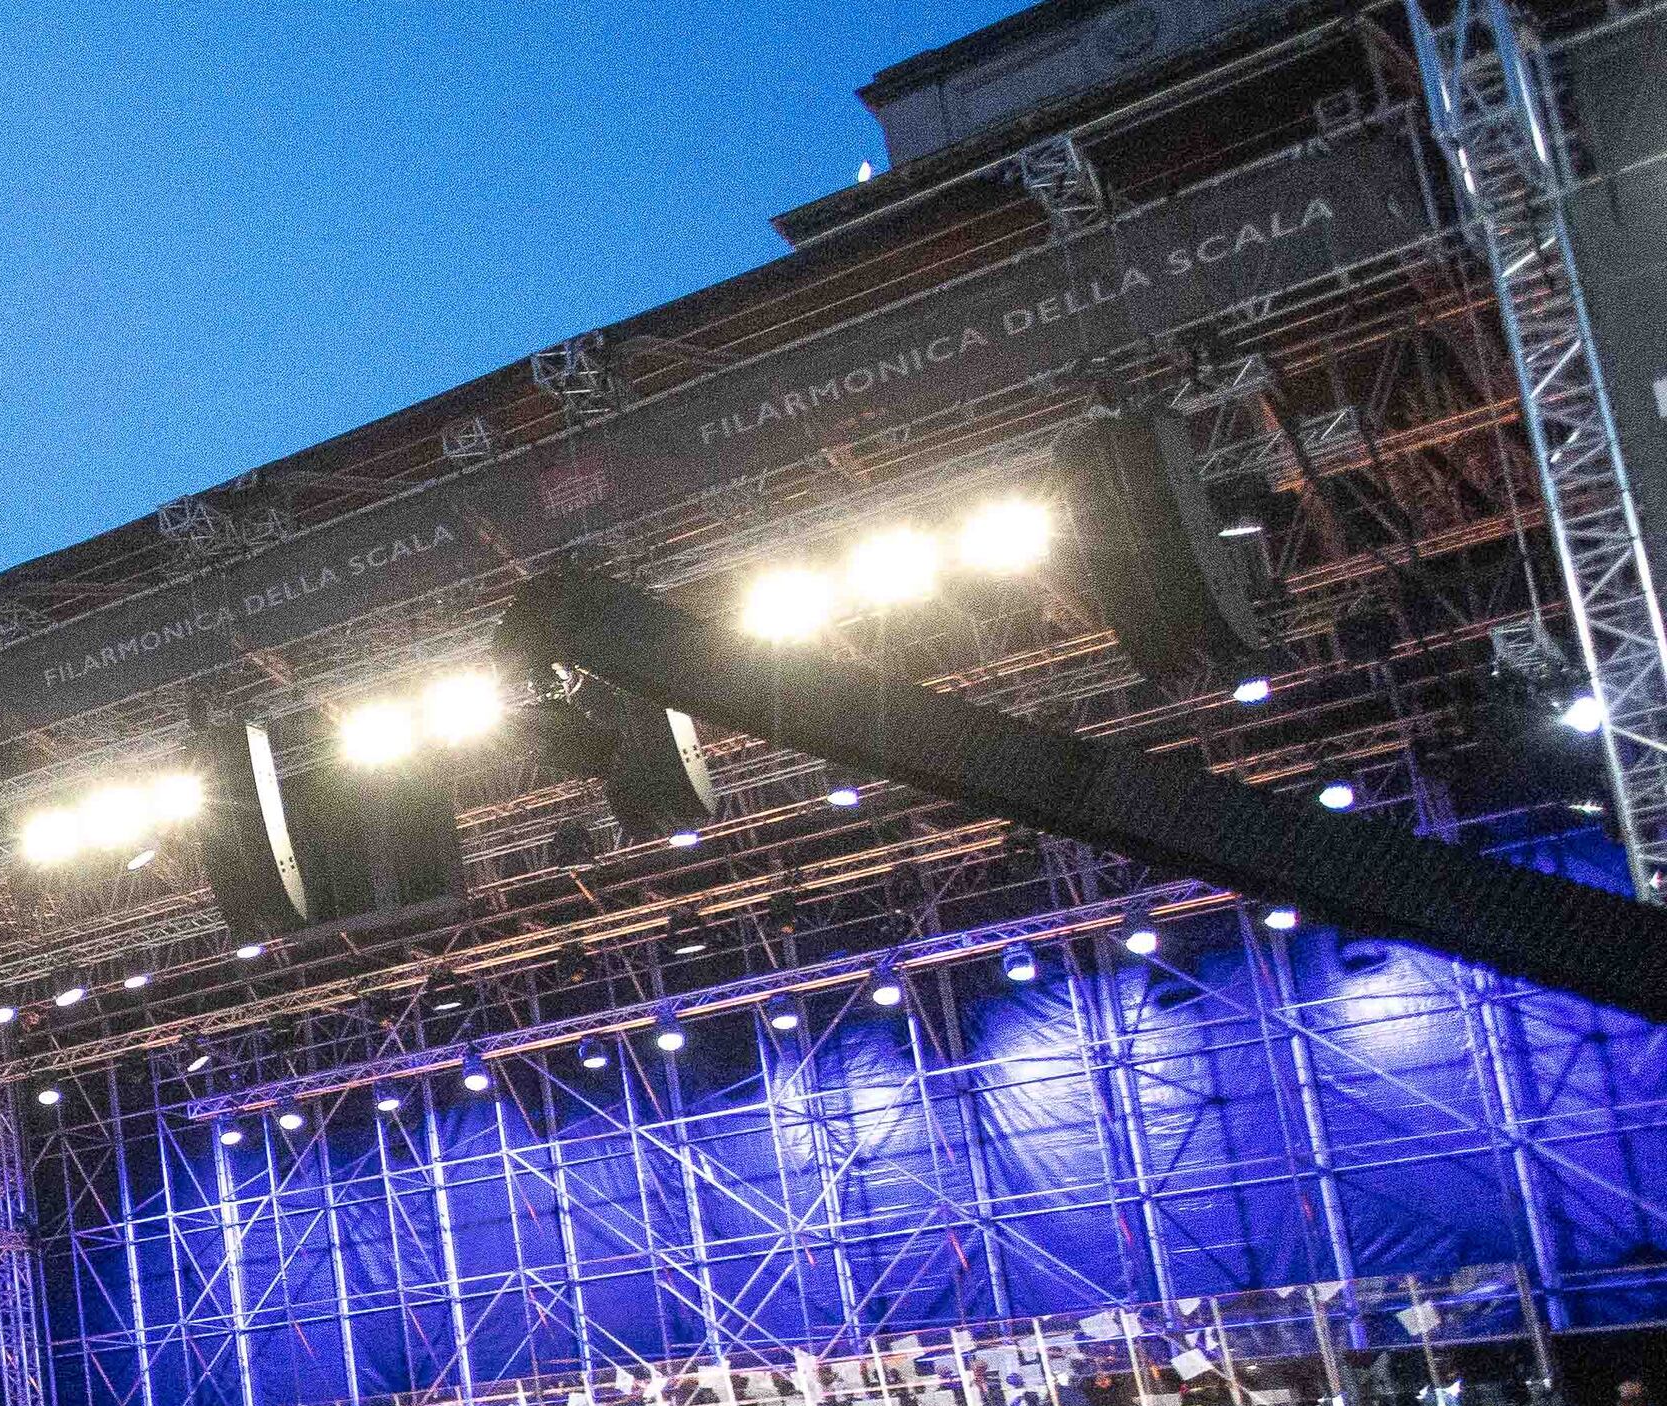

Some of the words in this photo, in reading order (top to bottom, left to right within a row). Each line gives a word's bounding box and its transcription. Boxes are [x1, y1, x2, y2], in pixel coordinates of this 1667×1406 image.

[699, 326, 986, 444] FILARMONICA
[1002, 267, 1150, 334] DELLA
[1166, 199, 1334, 276] SCALA
[42, 605, 235, 687] FILARMONICA
[244, 565, 342, 616] DELLA
[346, 524, 454, 577] SCALA
